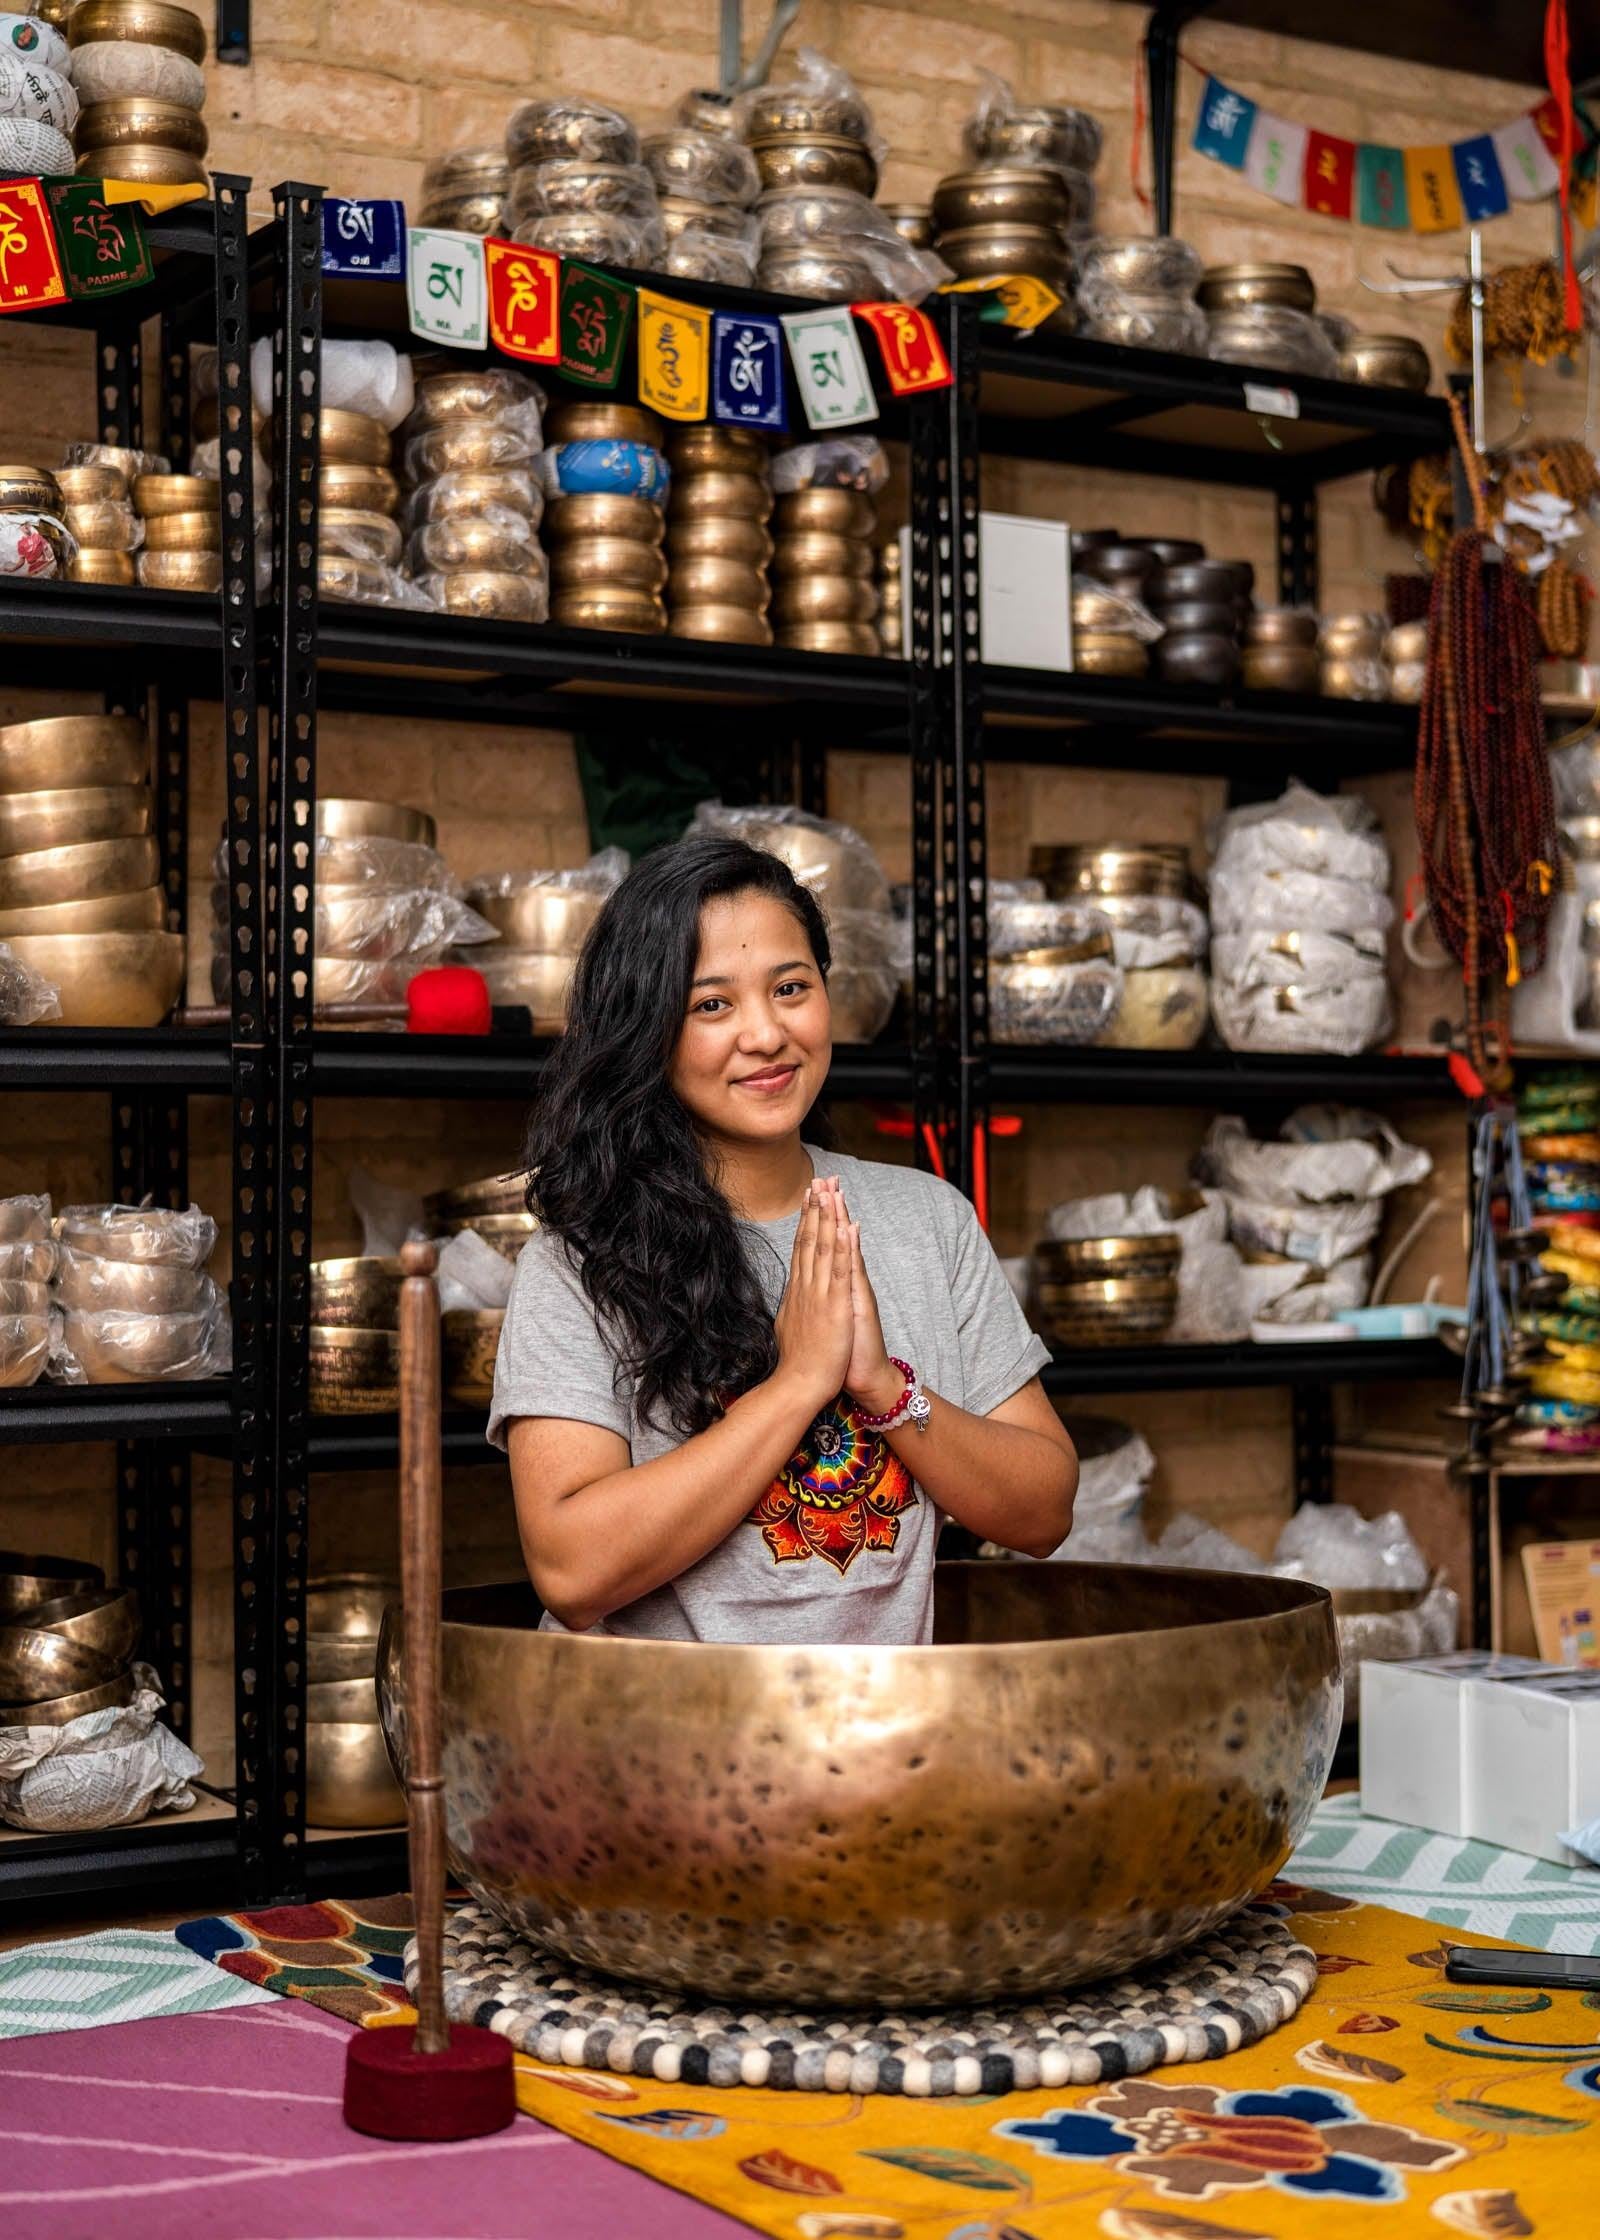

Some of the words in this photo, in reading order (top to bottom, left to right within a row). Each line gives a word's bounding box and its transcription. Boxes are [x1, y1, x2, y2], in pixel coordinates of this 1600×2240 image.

[350, 255, 370, 266] OM
[87, 271, 128, 285] PADME
[13, 285, 28, 297] NI
